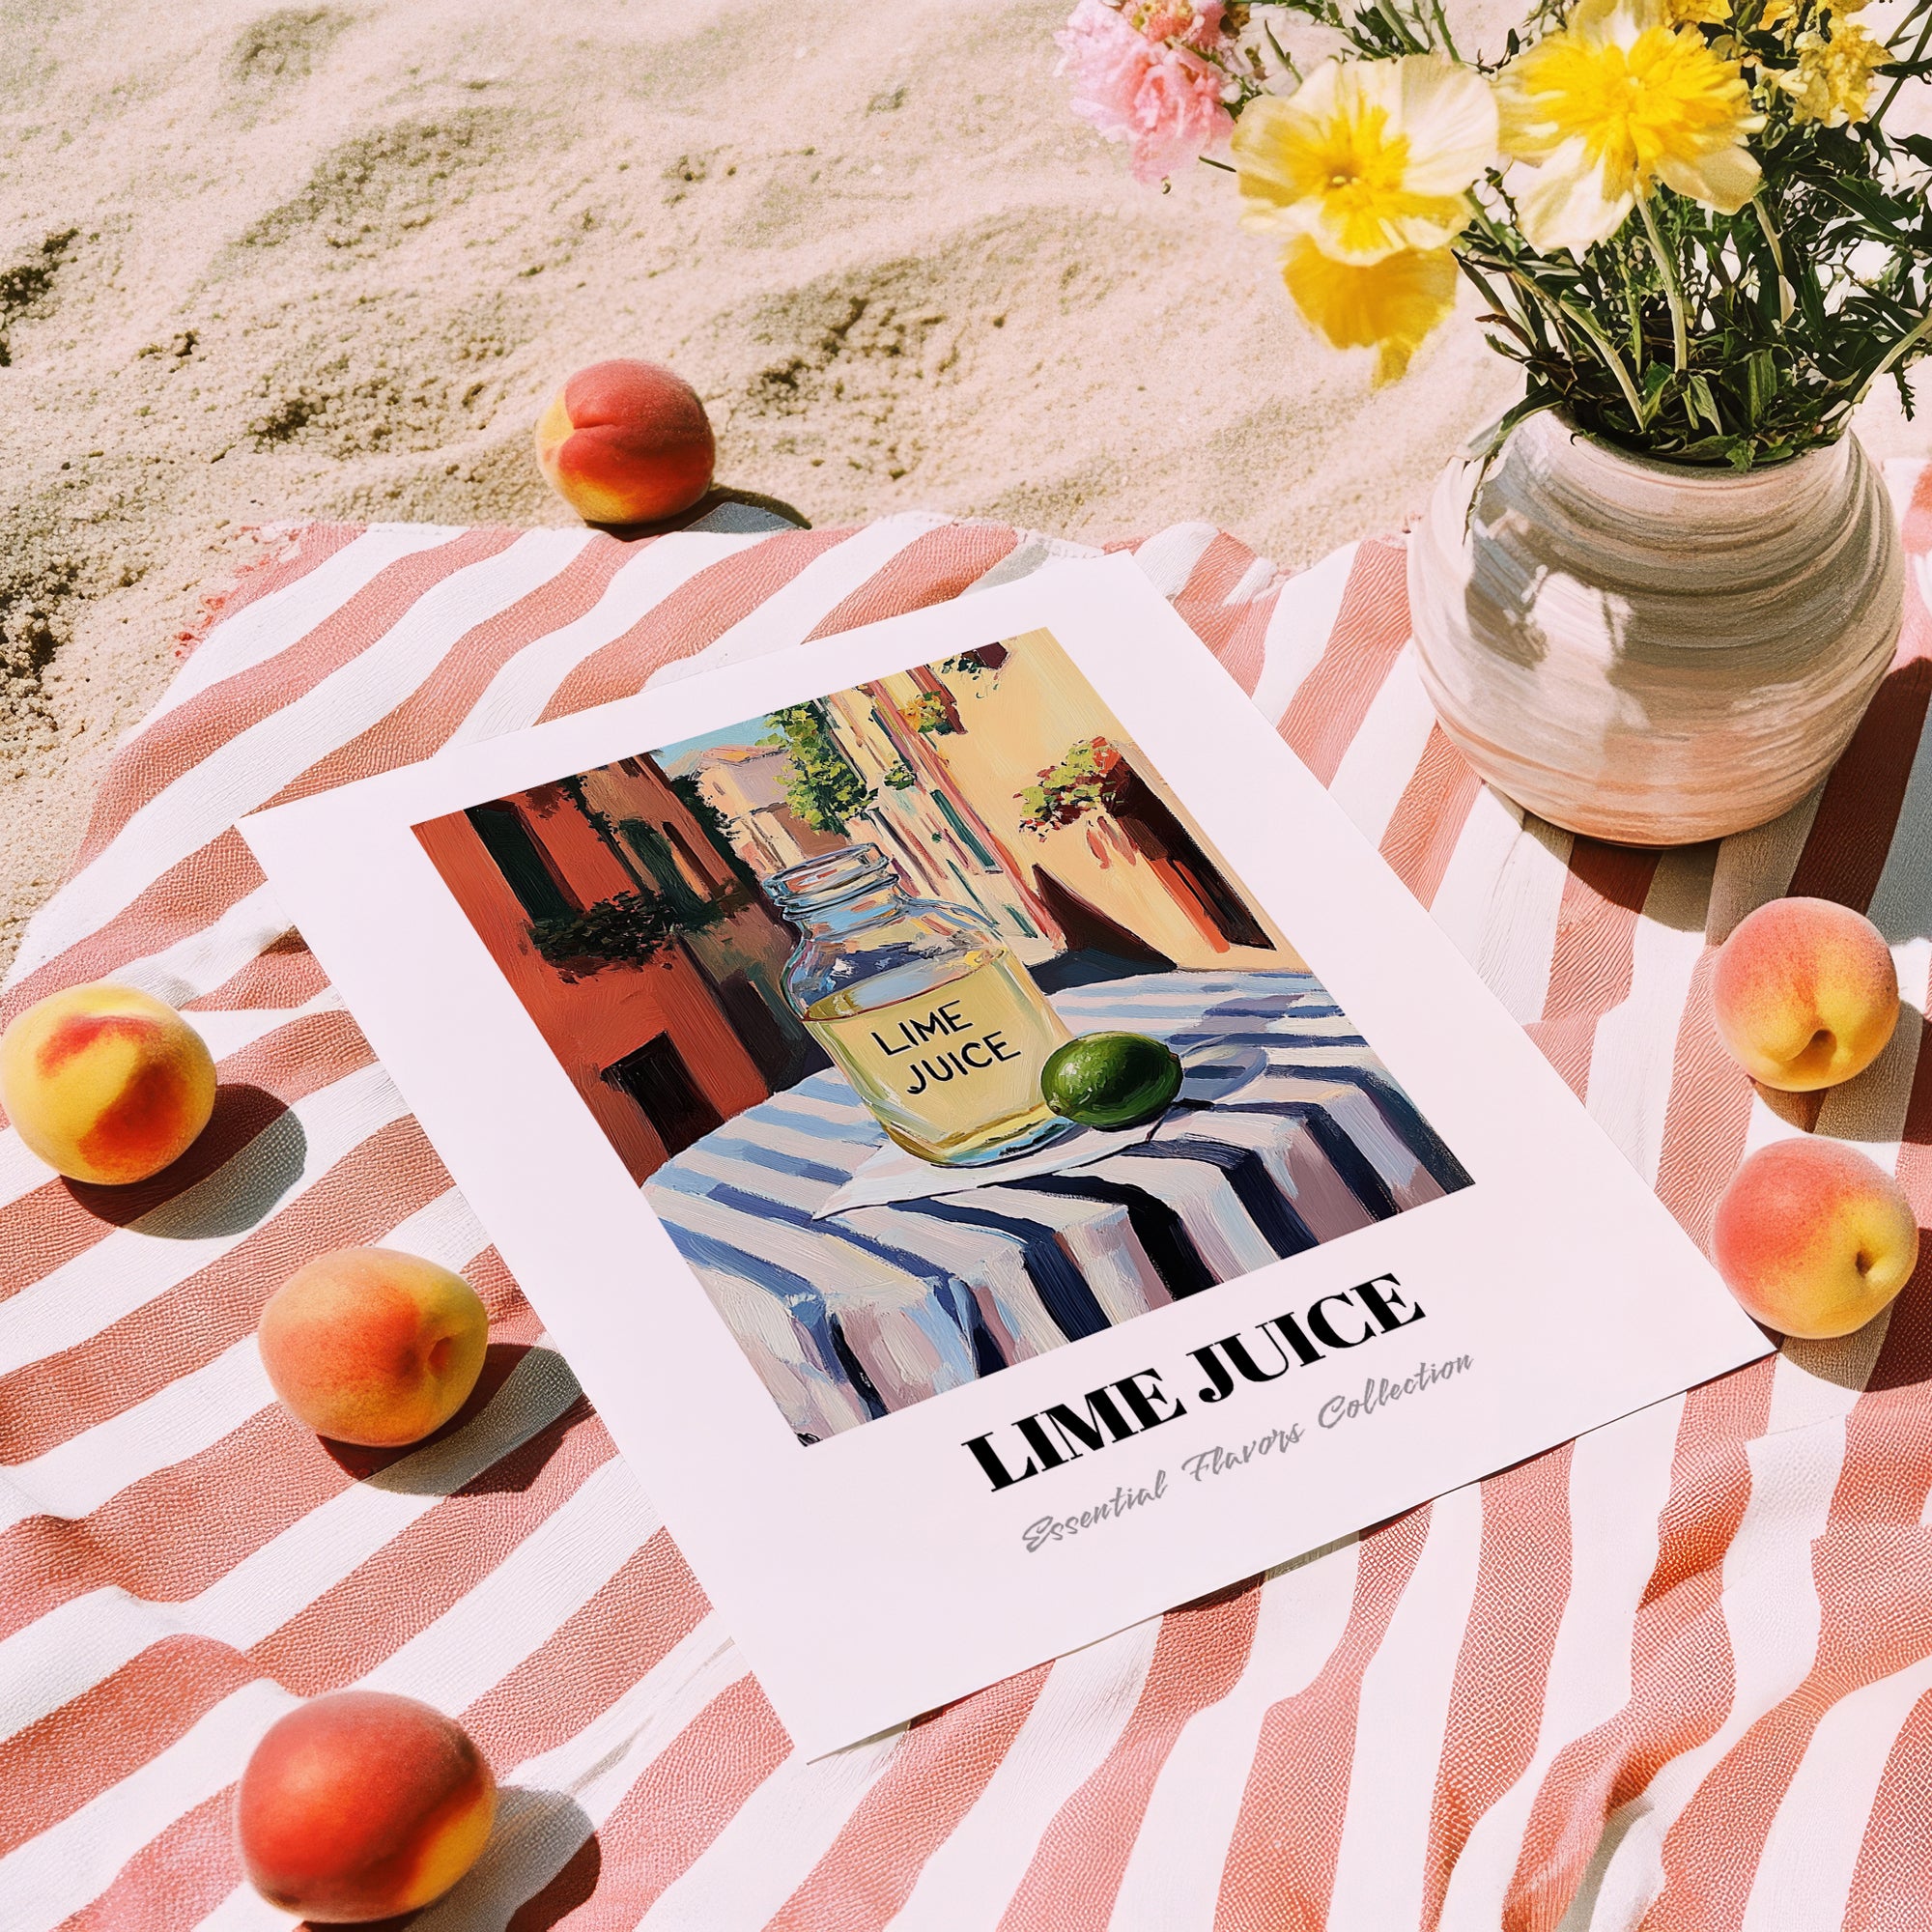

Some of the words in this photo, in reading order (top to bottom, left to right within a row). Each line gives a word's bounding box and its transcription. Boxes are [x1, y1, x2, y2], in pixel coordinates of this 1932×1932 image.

[871, 1000, 973, 1056] LIME
[907, 1031, 1021, 1094] JUICE
[961, 1368, 1187, 1492] LIME
[1186, 1273, 1426, 1403] JUICE
[1022, 1469, 1168, 1552] Essential
[1181, 1423, 1305, 1481] Flavors
[1319, 1354, 1474, 1429] Collection
